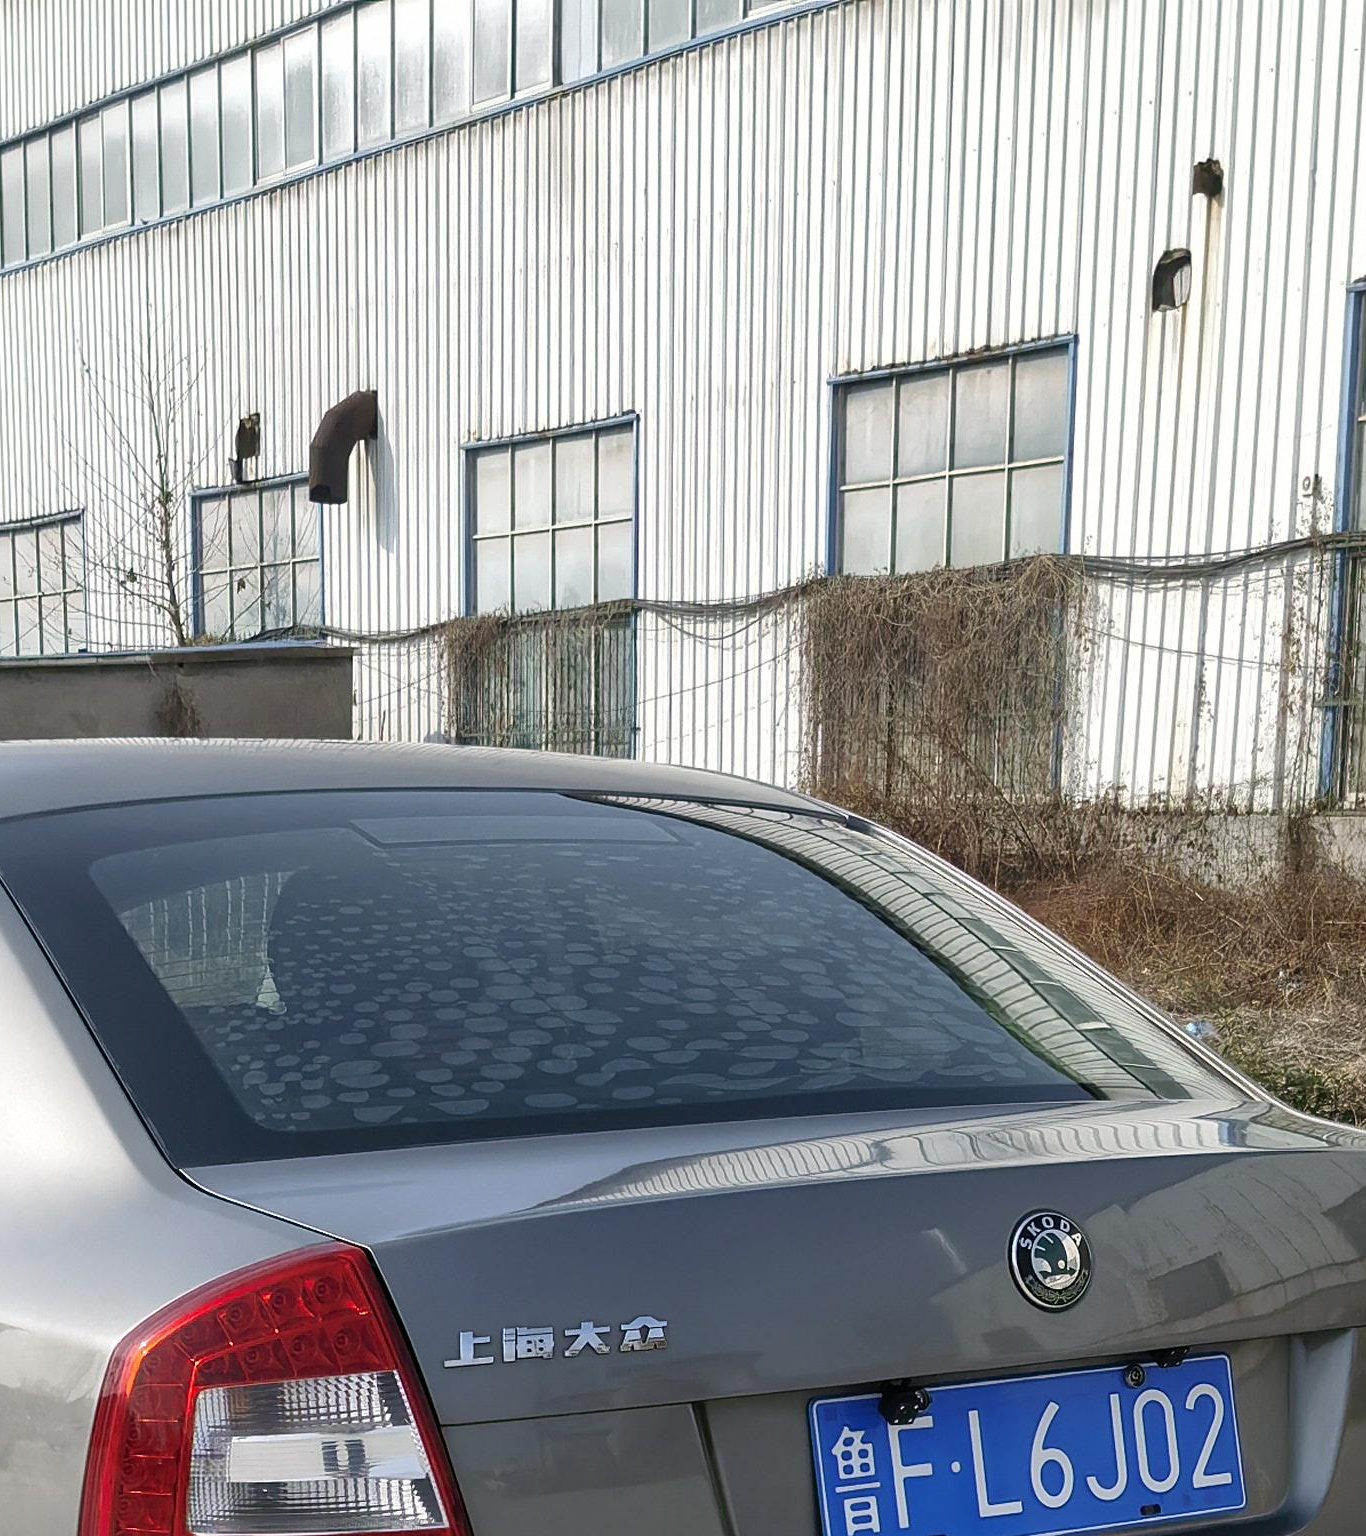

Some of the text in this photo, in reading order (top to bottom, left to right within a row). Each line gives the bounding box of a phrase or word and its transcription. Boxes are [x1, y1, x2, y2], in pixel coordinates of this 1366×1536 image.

[1019, 1216, 1082, 1250] SKODA
[443, 1315, 669, 1368] 上海大众
